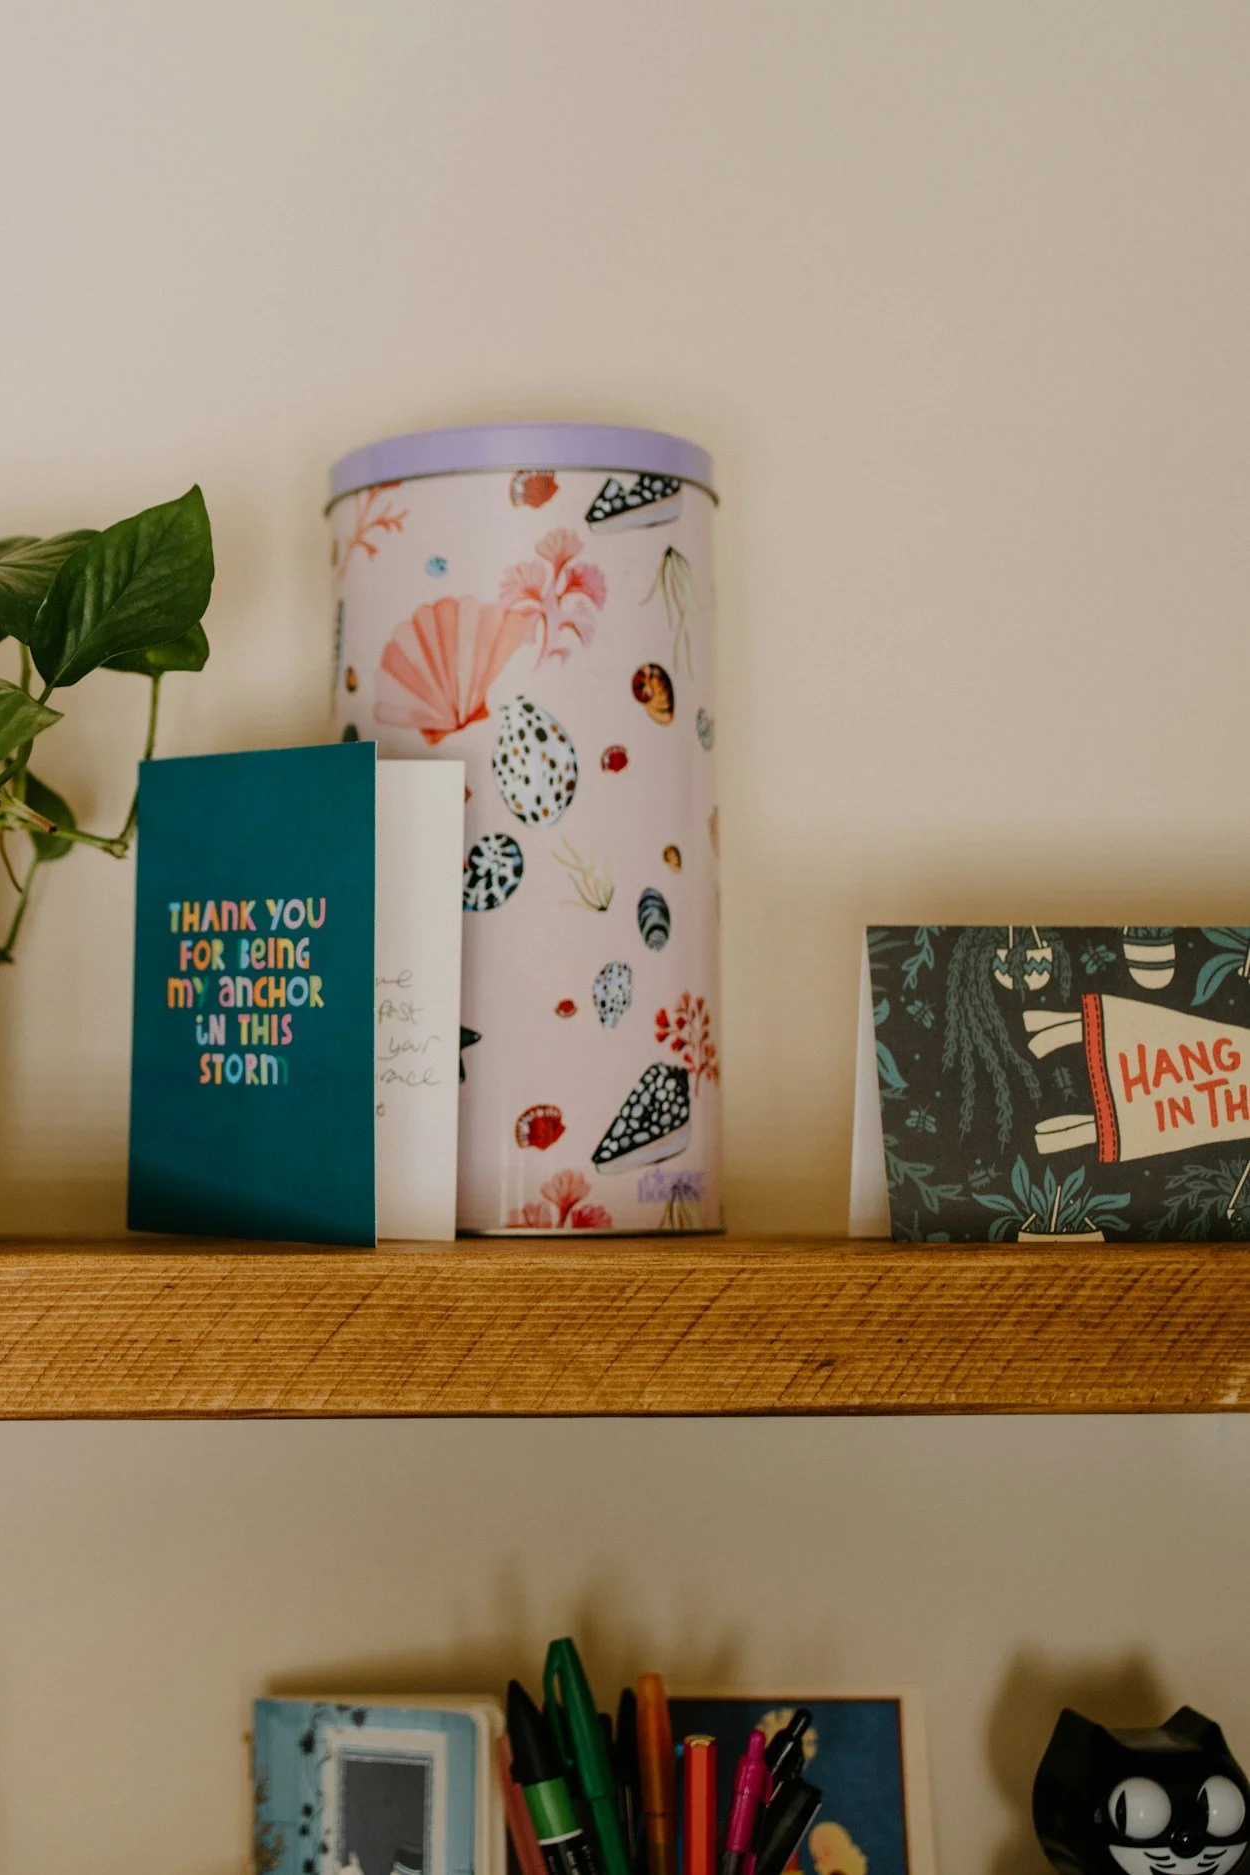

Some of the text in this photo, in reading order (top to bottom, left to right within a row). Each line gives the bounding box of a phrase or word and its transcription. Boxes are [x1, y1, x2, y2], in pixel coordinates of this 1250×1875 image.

[265, 897, 327, 931] YOU
[179, 938, 225, 972] FOR
[238, 1013, 293, 1046] THIS
[1118, 1037, 1241, 1103] HANG
[1154, 1096, 1195, 1133] IN
